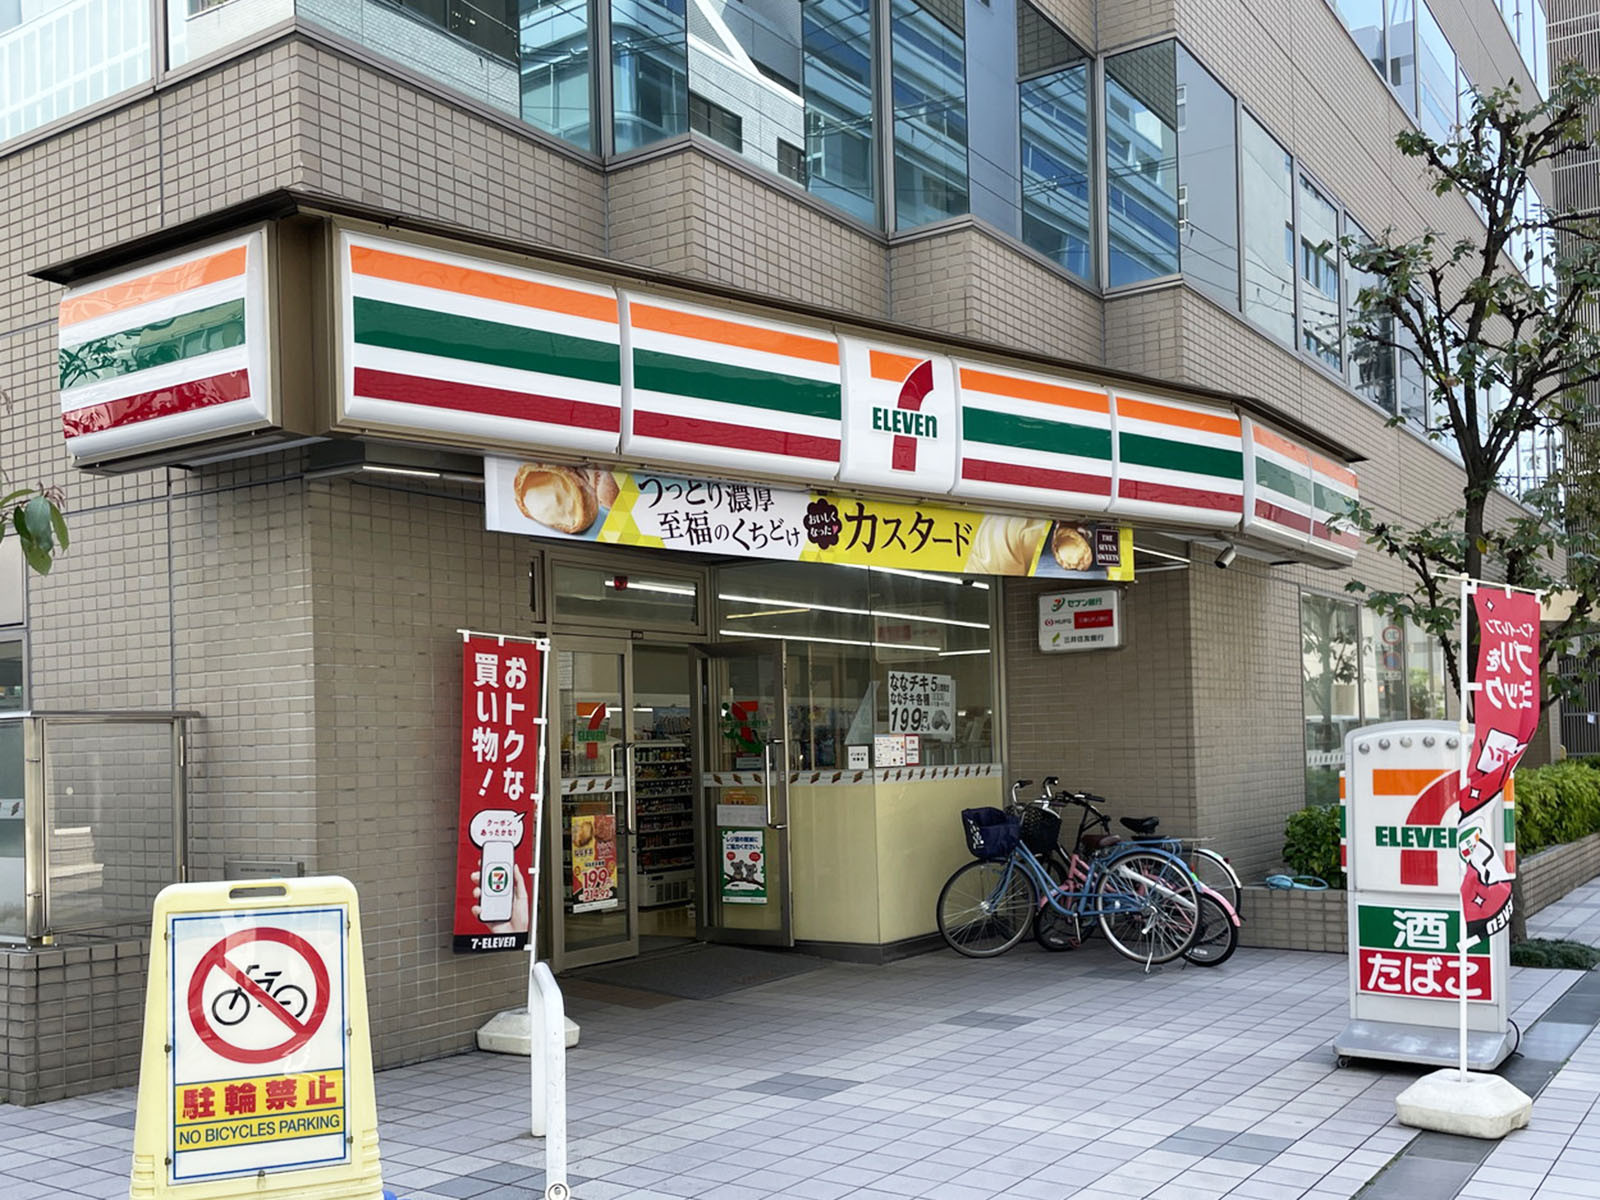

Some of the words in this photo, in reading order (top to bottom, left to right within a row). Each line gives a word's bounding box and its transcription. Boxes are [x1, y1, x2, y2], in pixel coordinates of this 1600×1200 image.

[657, 511, 800, 550] 至福のくちどけ
[808, 511, 837, 525] おいしく
[810, 525, 832, 537] なった
[844, 502, 973, 557] カスタード
[1098, 544, 1117, 552] SEVEN
[1102, 534, 1113, 542] THE
[1097, 553, 1119, 561] SWEETS
[890, 674, 929, 692] ななチキ
[472, 652, 500, 797] 買い物!
[503, 656, 528, 801] おトクな
[487, 819, 513, 827] クーポン
[1393, 909, 1449, 949] 酒
[1367, 953, 1482, 997] たばこ
[182, 1074, 337, 1120] 駐輪禁止
[179, 1130, 201, 1145] NO
[205, 1121, 276, 1142] BICYCLES
[279, 1113, 340, 1134] PARKING
